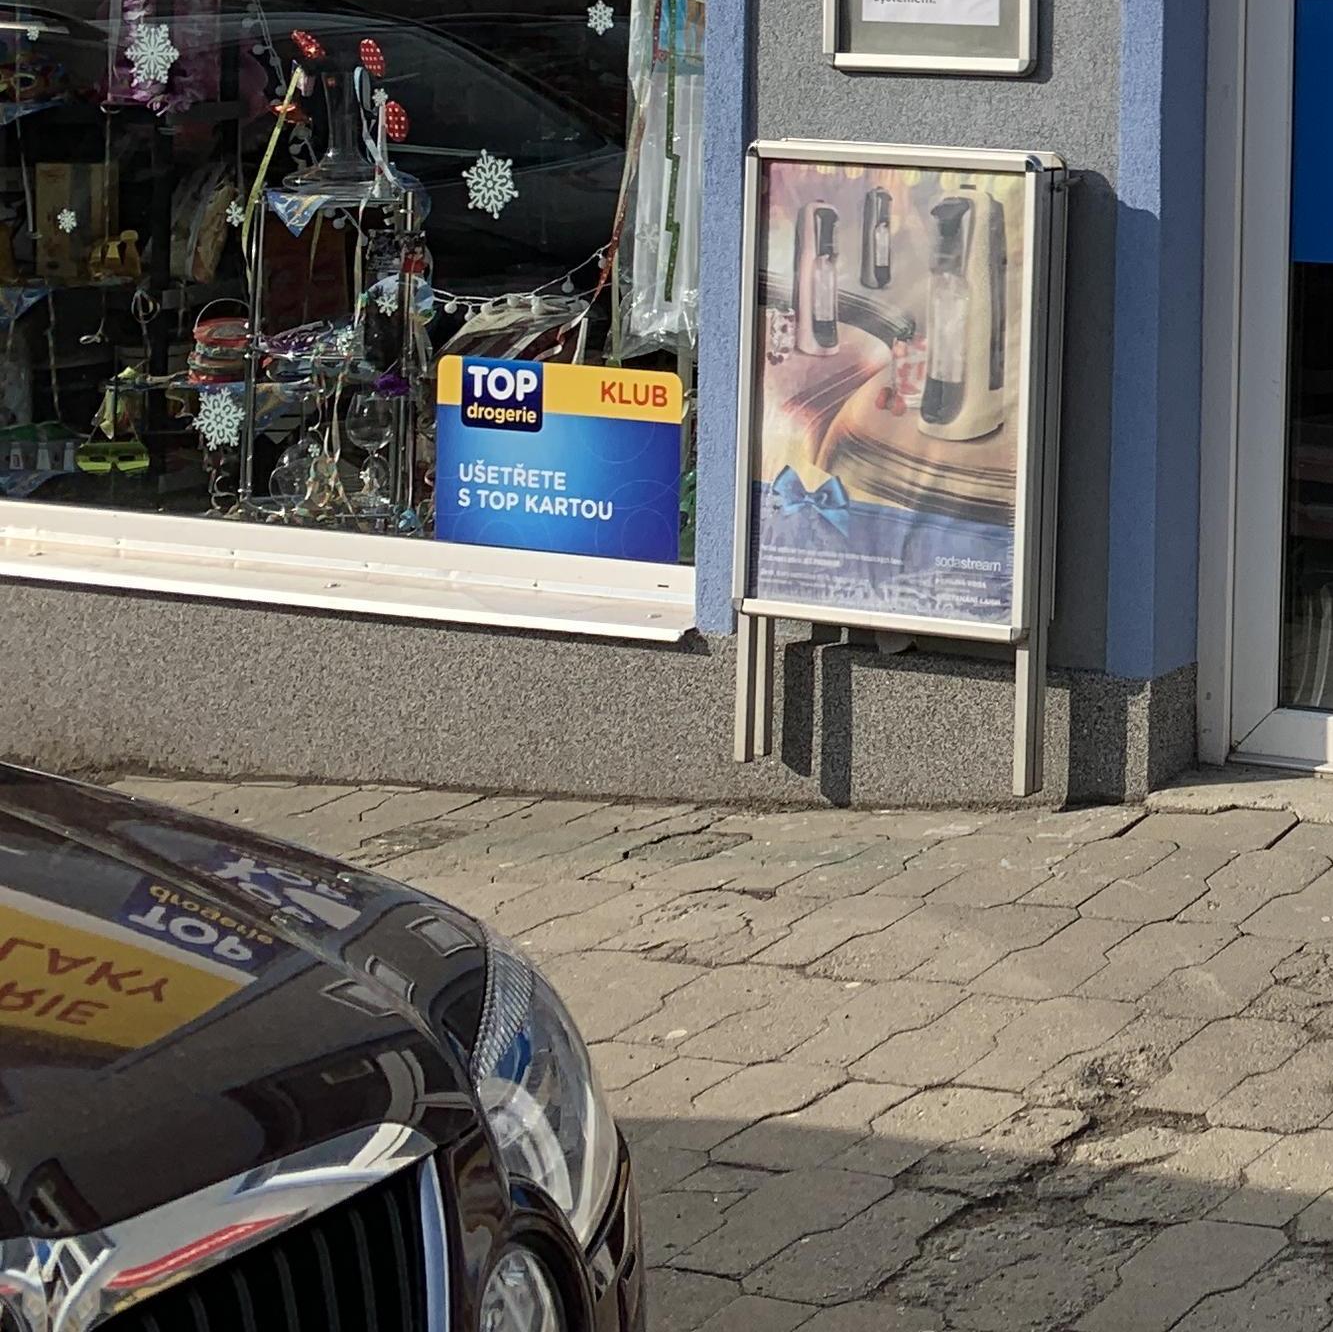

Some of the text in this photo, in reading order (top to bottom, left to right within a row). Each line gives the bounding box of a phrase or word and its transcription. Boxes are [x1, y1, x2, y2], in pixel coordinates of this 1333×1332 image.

[468, 365, 668, 407] TOP KLUB
[467, 402, 537, 424] drogerie
[458, 459, 567, 491] UŠETŘETE
[458, 488, 613, 520] S TOP KARTOU
[935, 555, 1001, 572] sodastream
